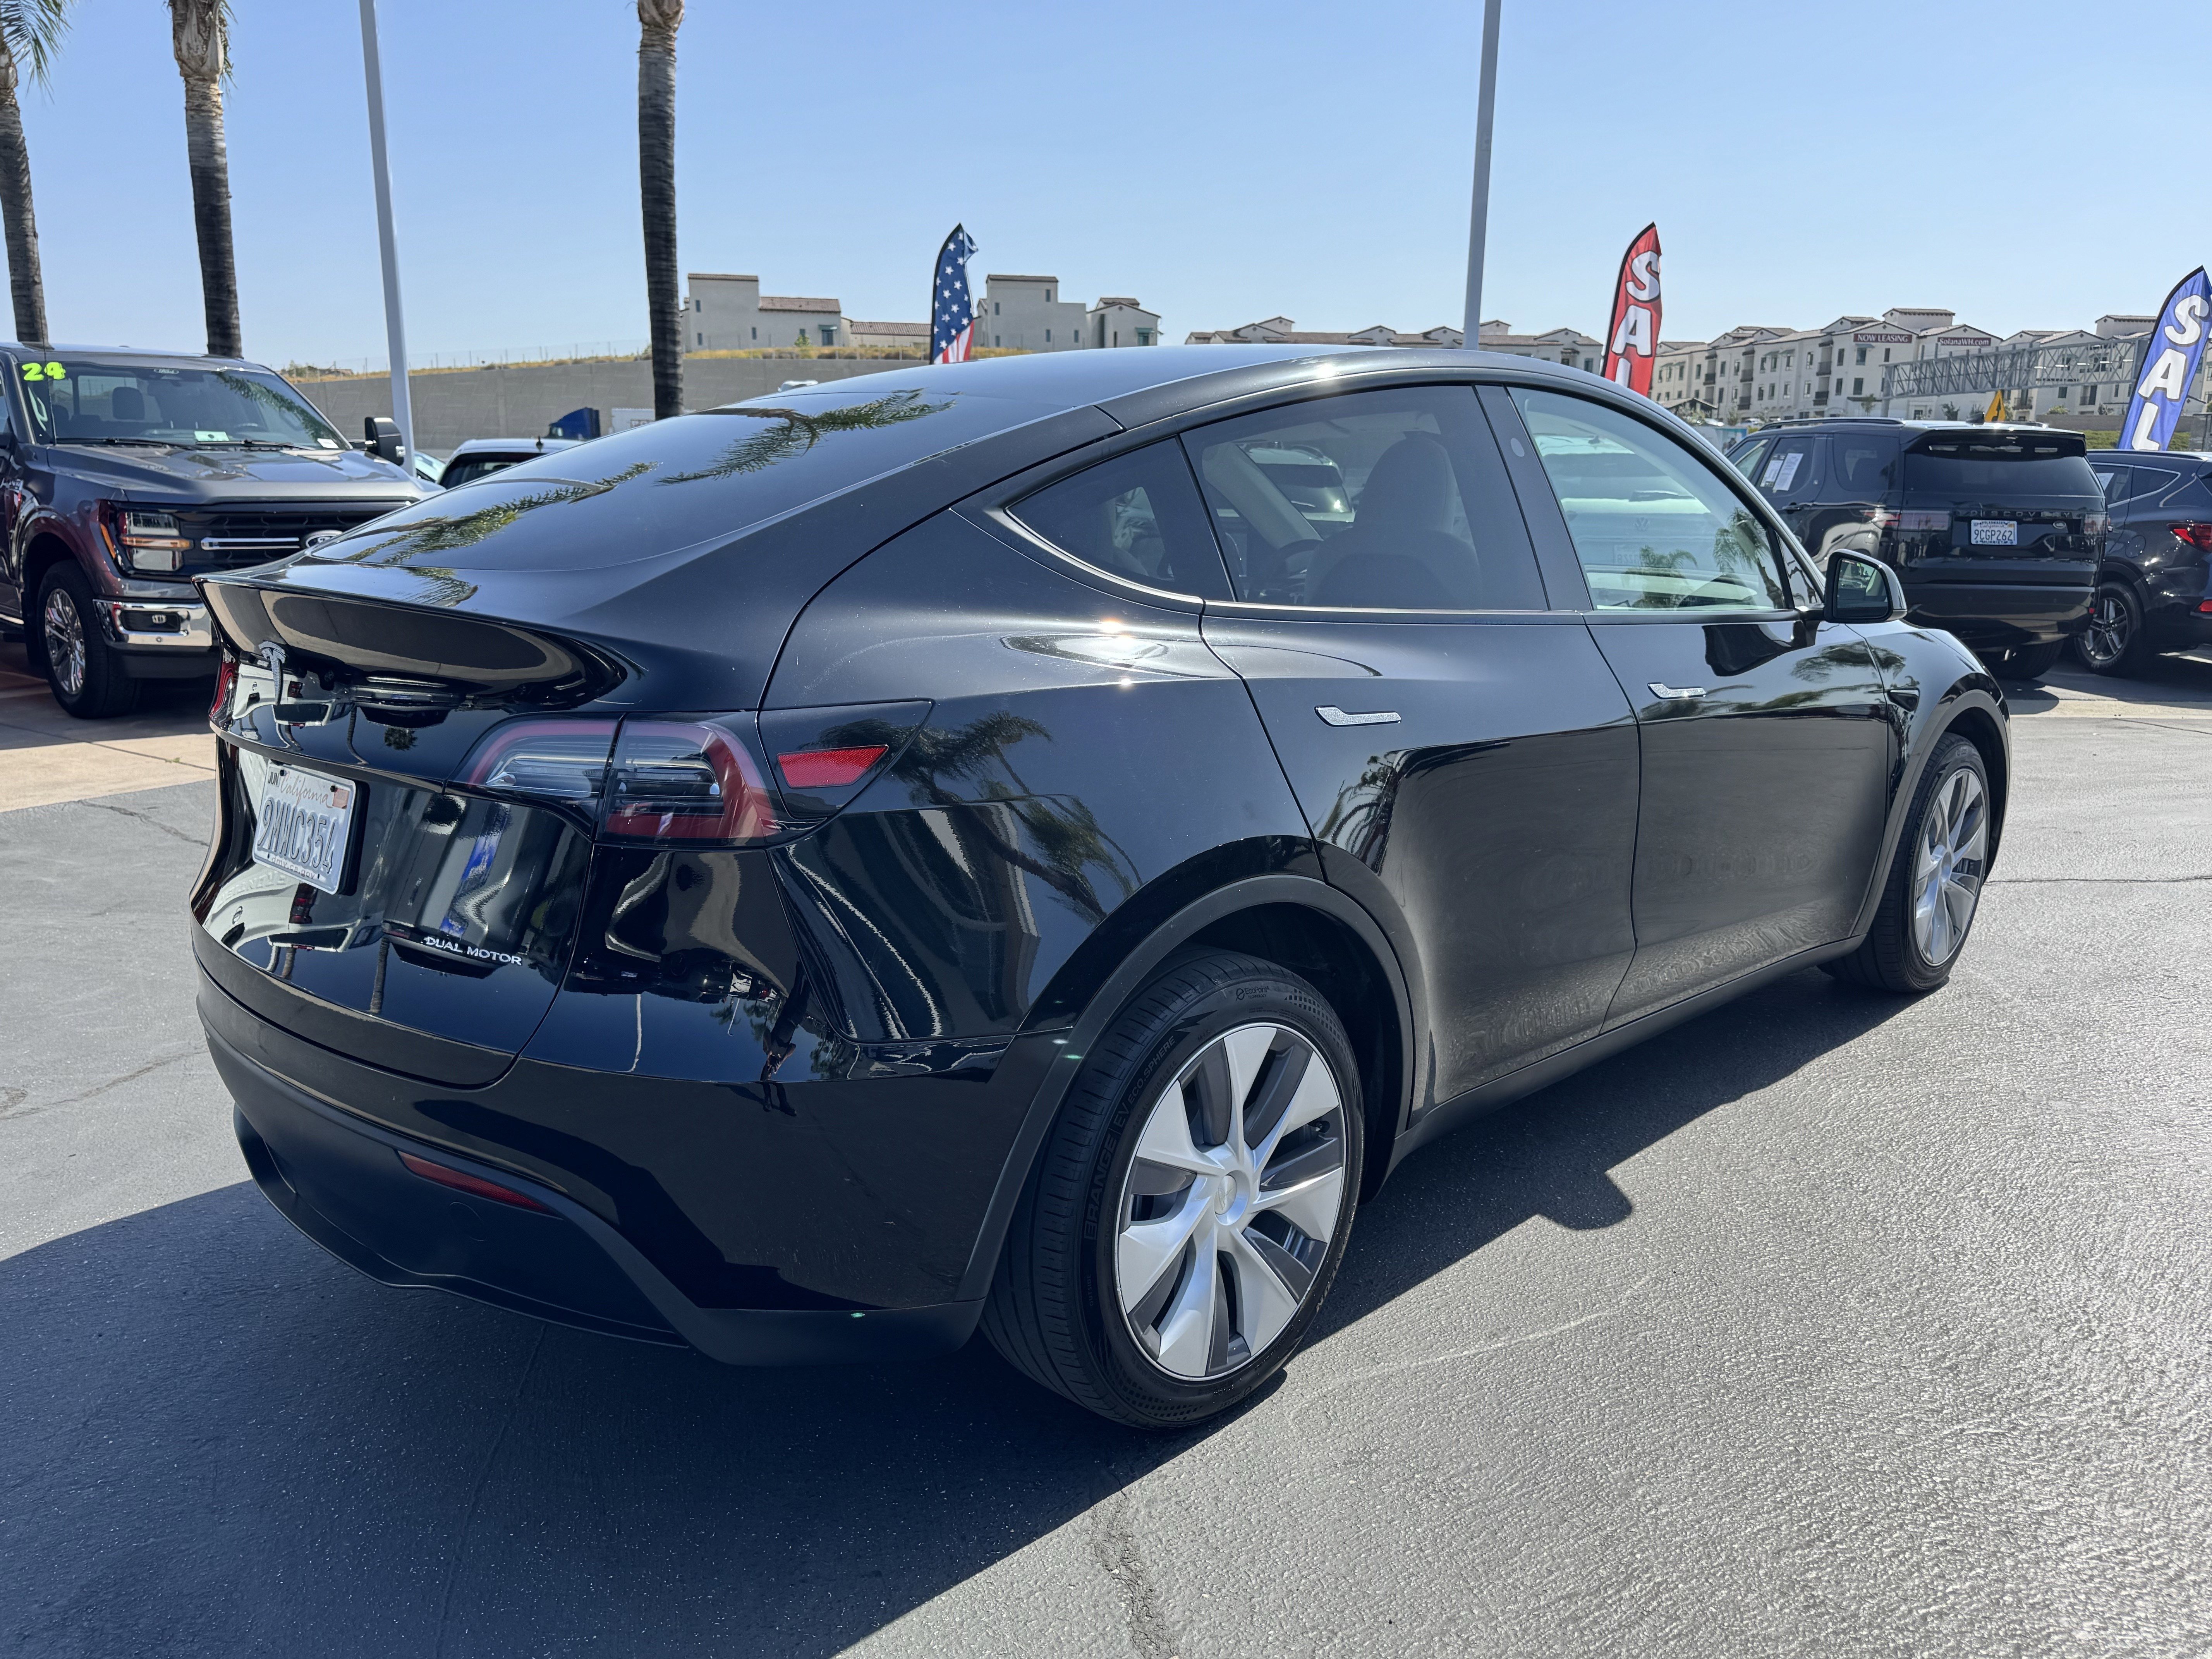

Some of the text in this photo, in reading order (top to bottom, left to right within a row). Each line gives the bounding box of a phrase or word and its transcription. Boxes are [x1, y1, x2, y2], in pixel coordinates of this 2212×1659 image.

[22, 362, 66, 381] 24
[1974, 529, 2013, 541] 9CGP262
[268, 771, 280, 786] JUN
[280, 772, 333, 809] California
[257, 799, 336, 874] 9MWC354
[271, 857, 316, 879] dmv.ca.gov
[425, 936, 522, 965] DUAL MOTOR
[1085, 1132, 1117, 1239] ERANGE
[1114, 1102, 1130, 1128] EV
[1127, 1036, 1176, 1105] ECO.SPHERE
